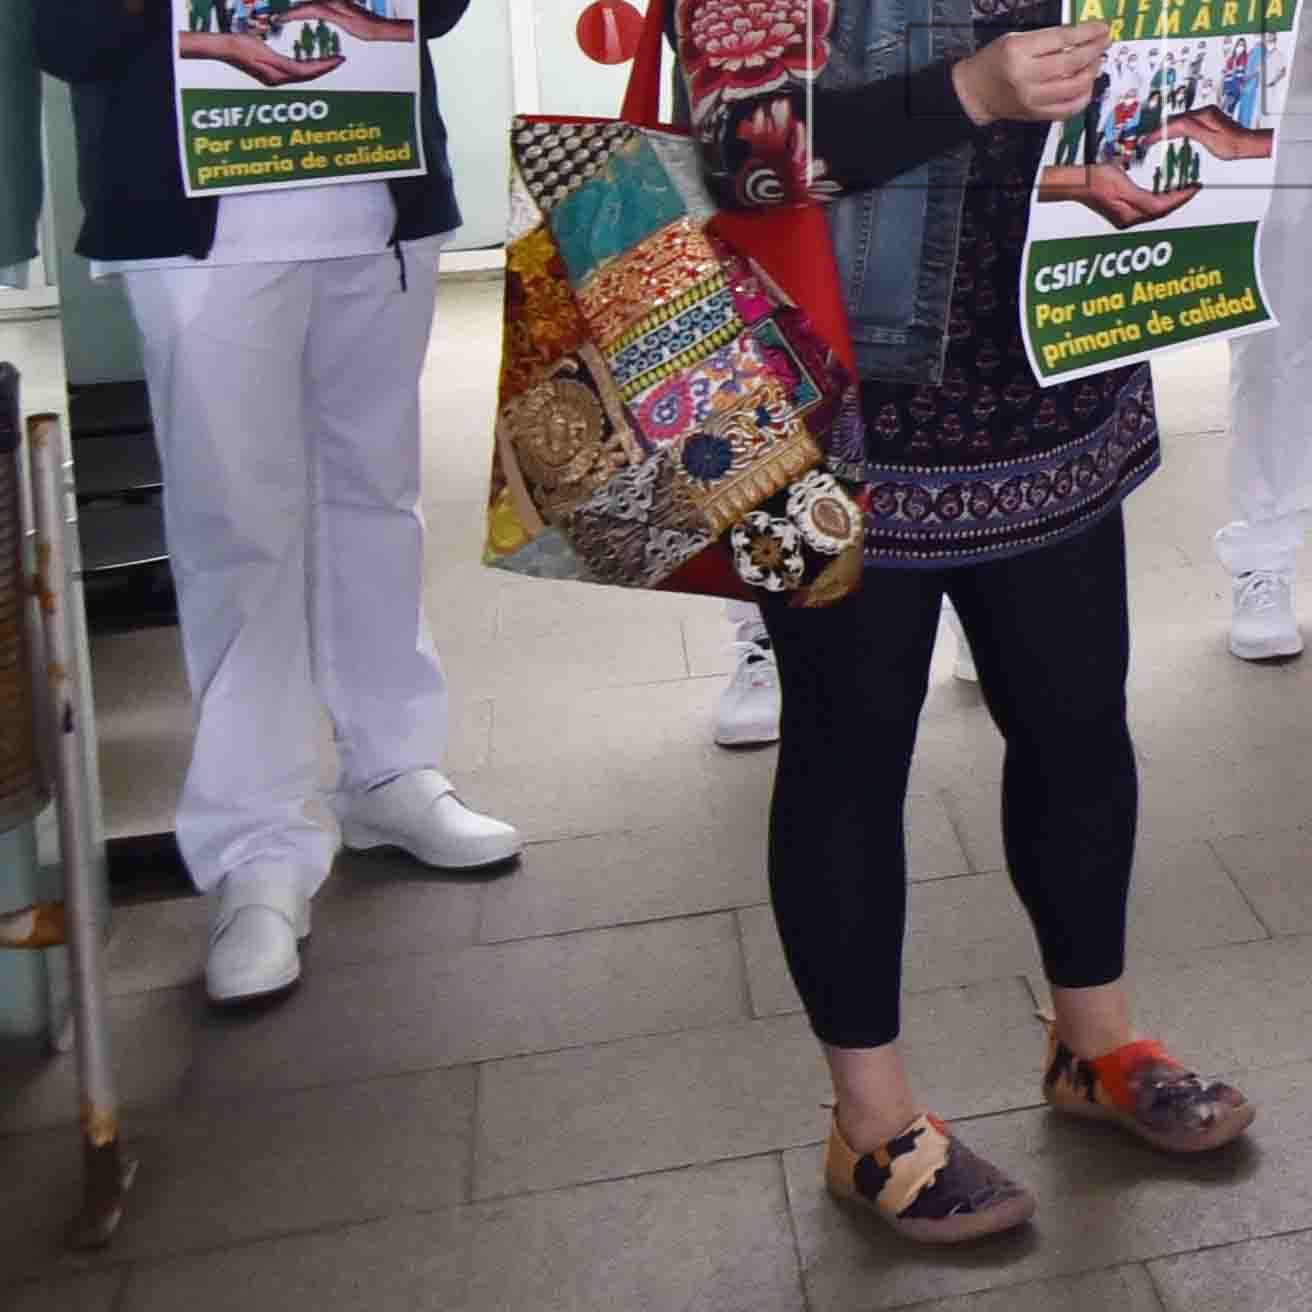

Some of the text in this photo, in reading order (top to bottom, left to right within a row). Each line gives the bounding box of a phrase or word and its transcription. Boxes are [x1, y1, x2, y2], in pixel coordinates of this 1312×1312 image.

[191, 100, 329, 129] CSIF/CCOO
[193, 122, 381, 155] Por una Atención
[198, 142, 412, 185] primaria de calidad
[1034, 241, 1173, 292] CSIF/CCOO
[1036, 266, 1223, 328] Por una Atención
[1041, 288, 1257, 368] primaria de calidad
